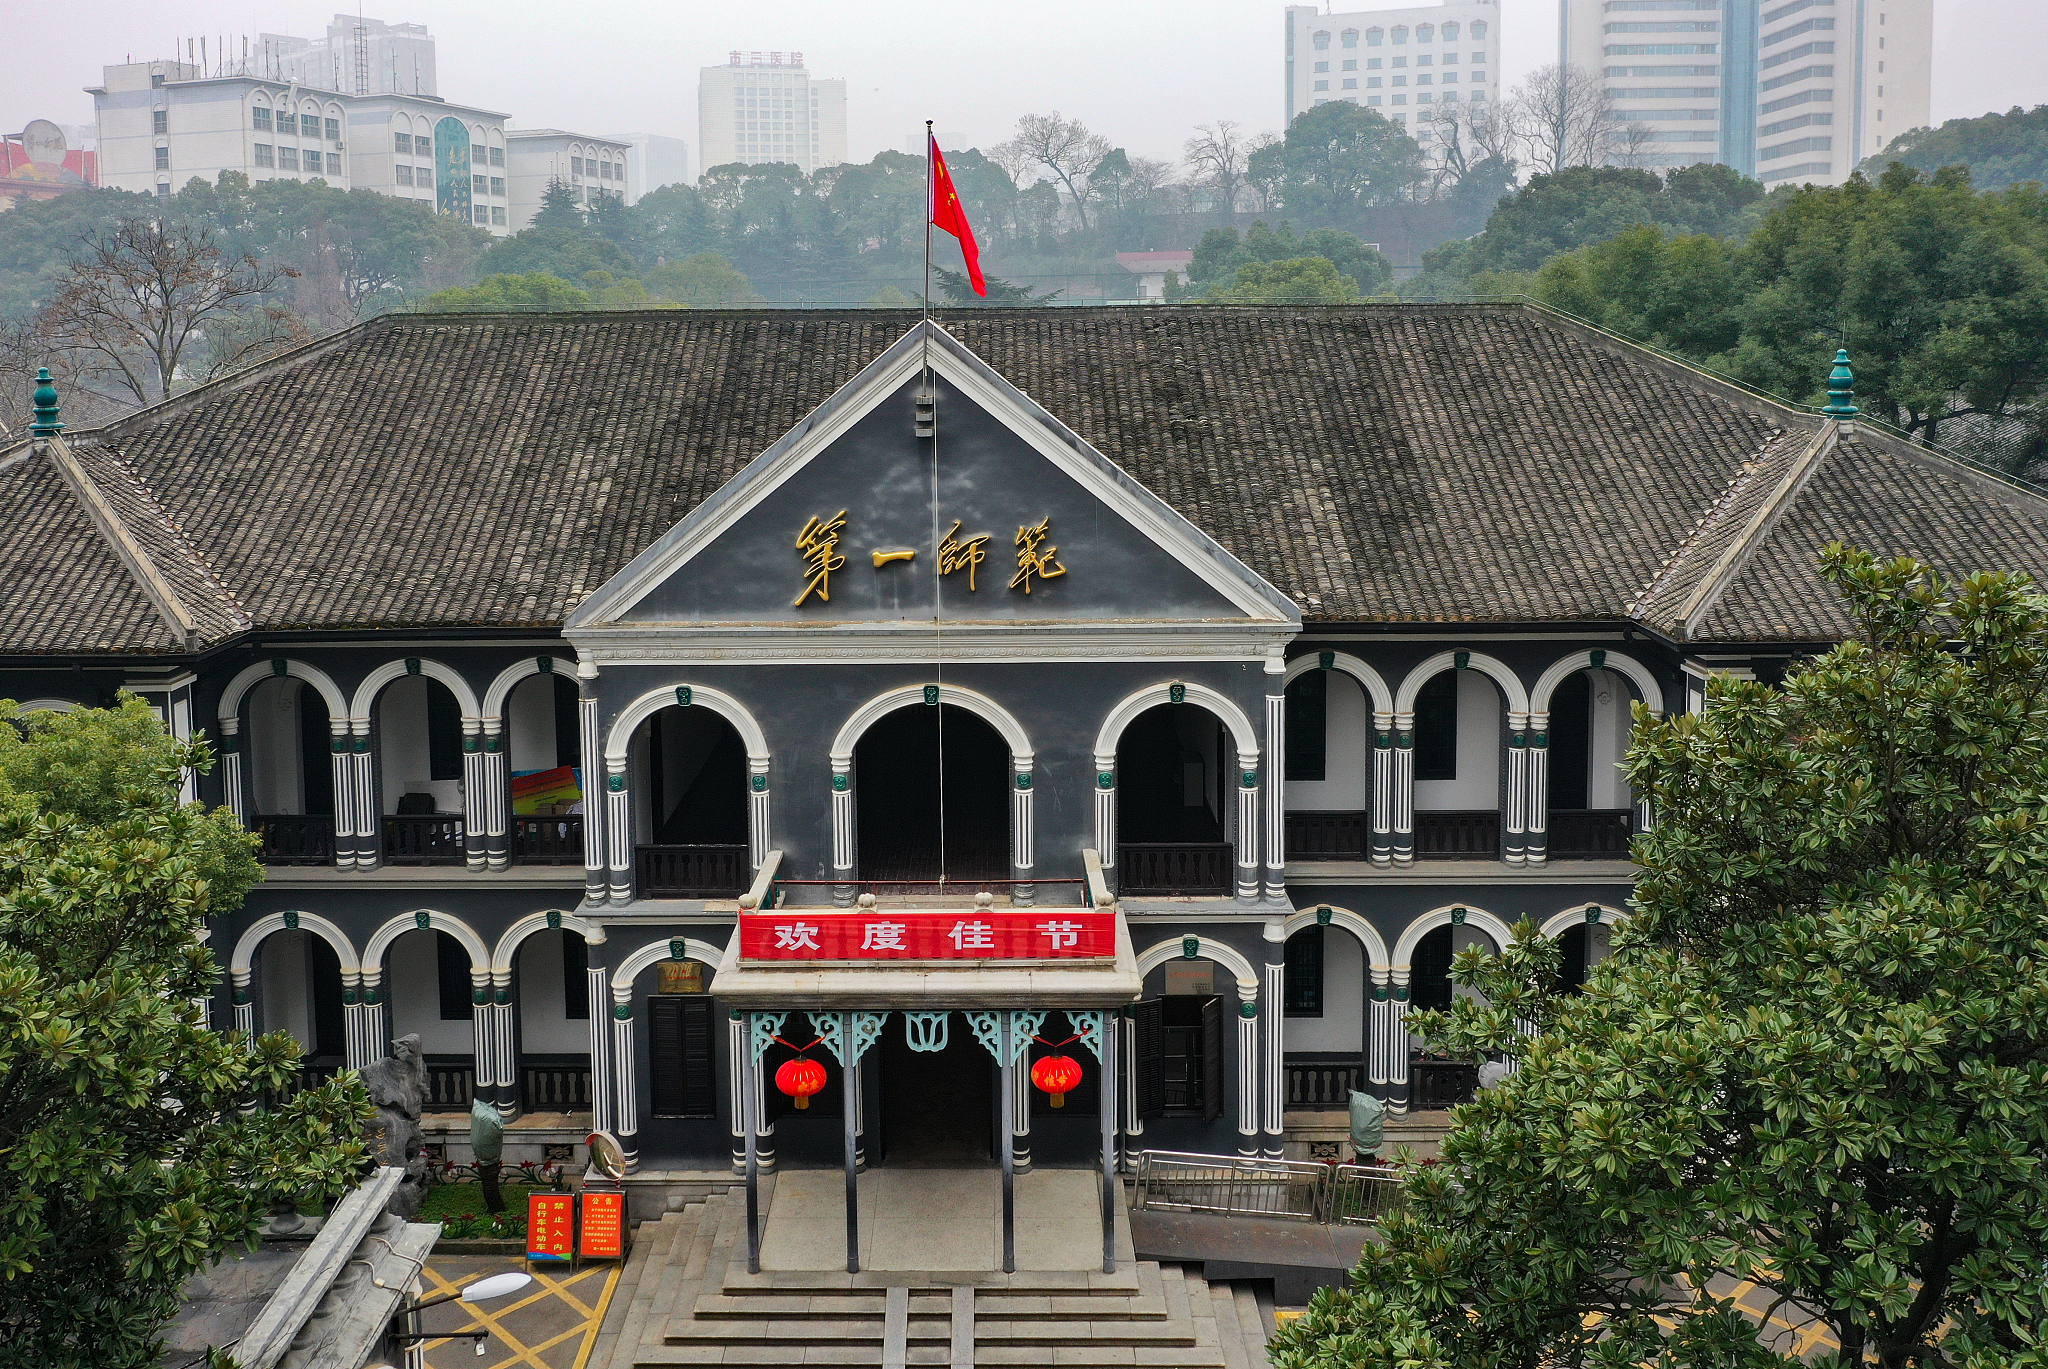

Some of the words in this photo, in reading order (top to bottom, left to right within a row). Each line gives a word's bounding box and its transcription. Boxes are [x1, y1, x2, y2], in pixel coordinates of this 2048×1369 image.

[729, 50, 804, 67] 市三医院
[774, 920, 1083, 951] 欢度佳节
[592, 1197, 612, 1205] 公告
[536, 1202, 547, 1250] 自行车电动车
[553, 1202, 564, 1250] 禁止入内
